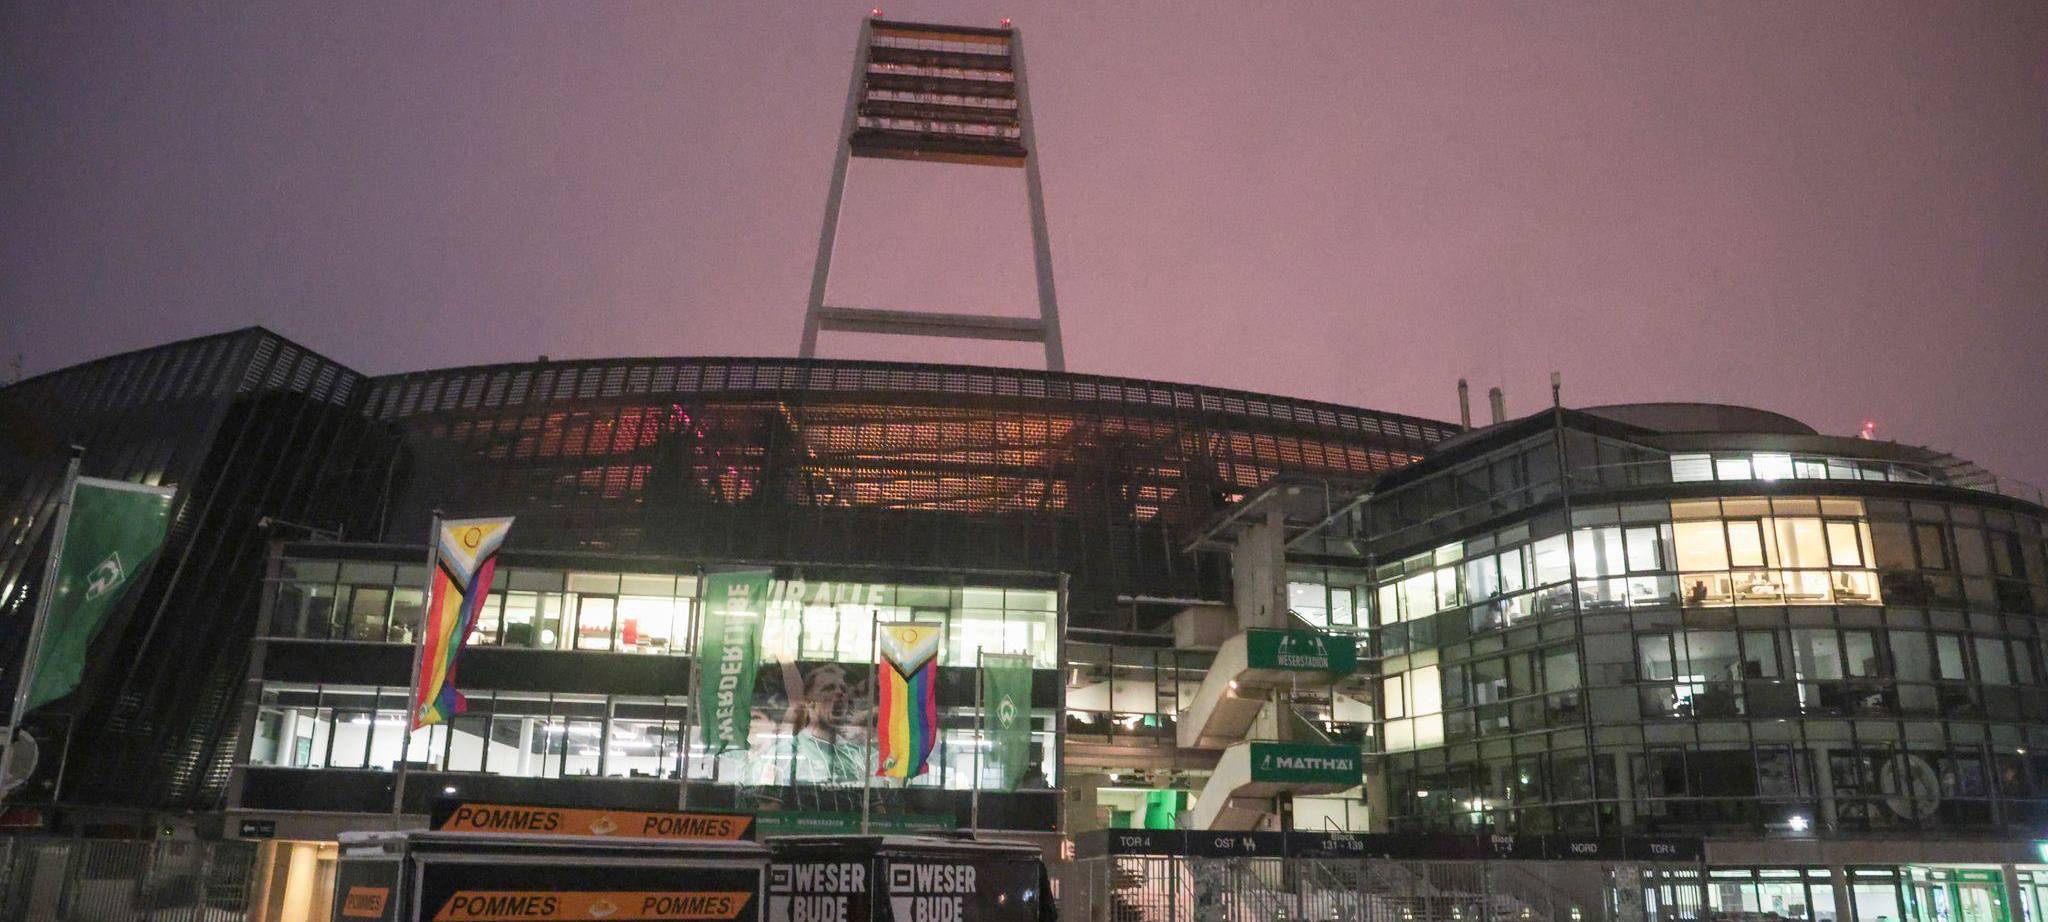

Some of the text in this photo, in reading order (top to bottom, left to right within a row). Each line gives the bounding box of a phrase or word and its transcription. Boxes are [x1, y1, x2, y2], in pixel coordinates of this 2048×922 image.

[1276, 756, 1353, 771] MATTHÄI
[453, 808, 560, 831] POMMES
[643, 816, 731, 836] POMMES
[1120, 836, 1151, 847] TOR 4
[1214, 838, 1235, 849] OST
[1491, 834, 1514, 843] Block
[1571, 843, 1598, 854] NORD
[1649, 843, 1676, 854] TOR 4
[795, 863, 866, 893] WESER
[916, 864, 976, 893] WESER
[450, 896, 558, 917] POMMES
[641, 896, 730, 915] POMMES
[794, 896, 848, 922] BUDE
[915, 896, 963, 922] BUDE
